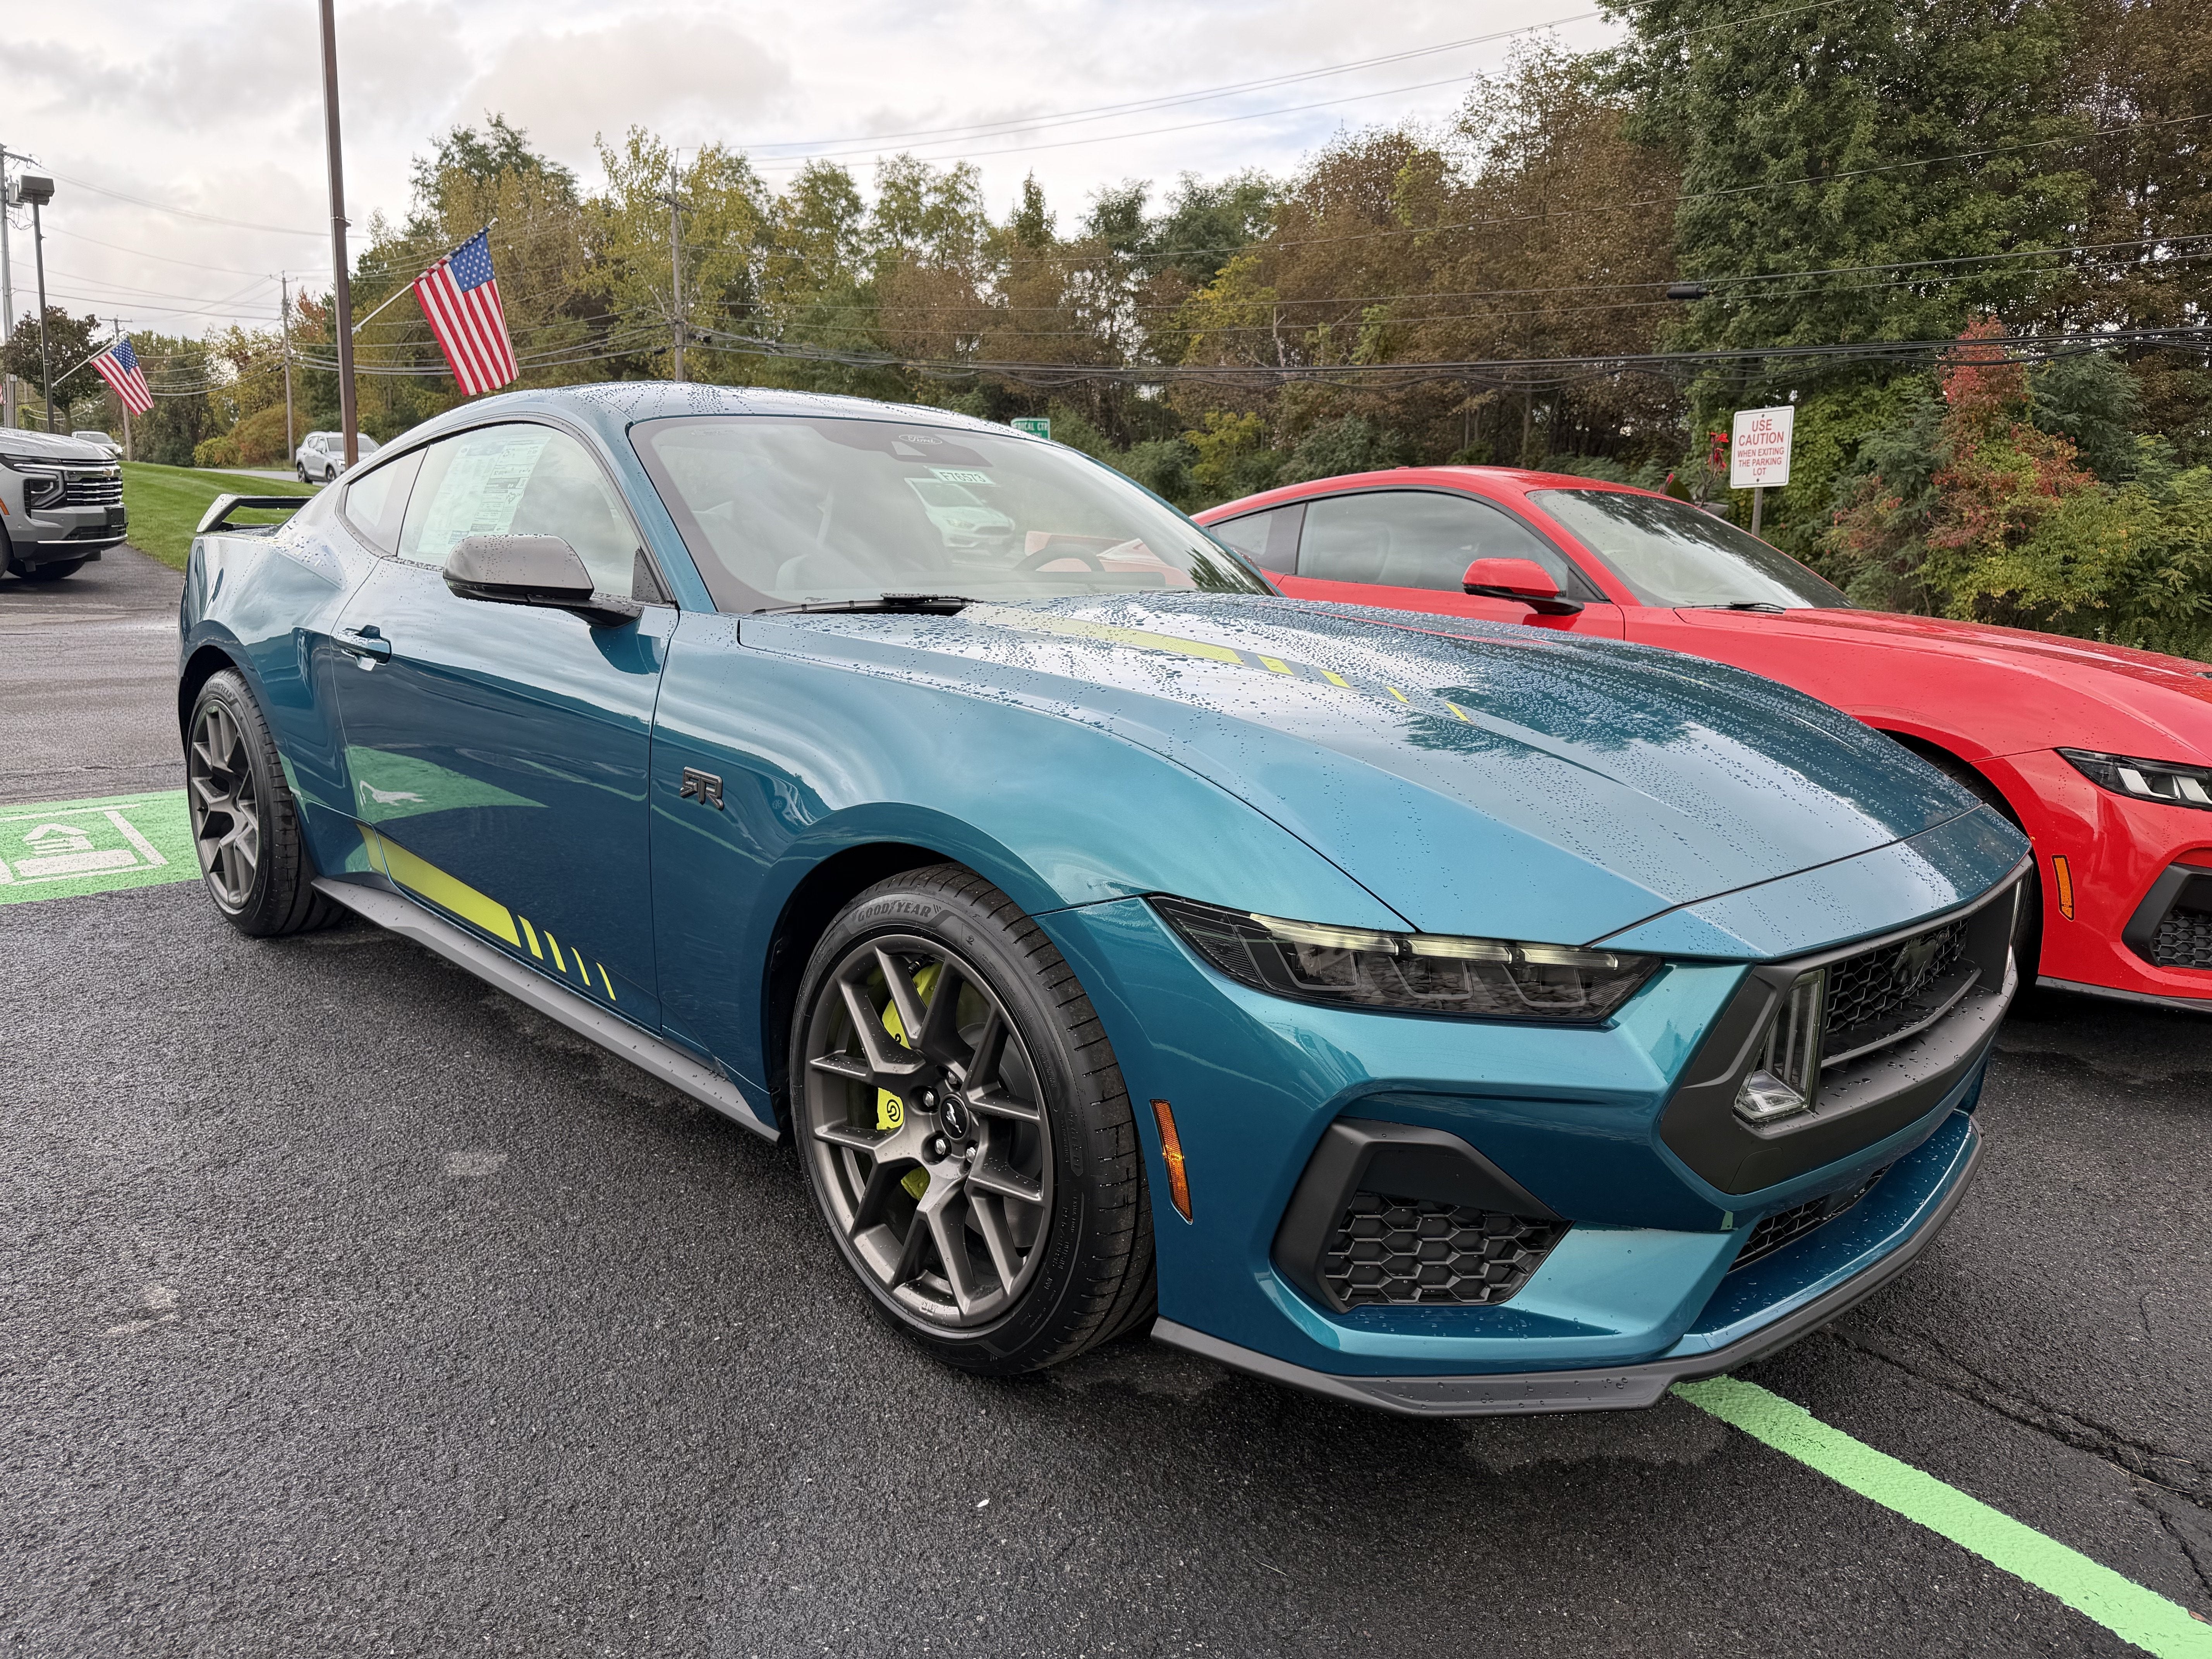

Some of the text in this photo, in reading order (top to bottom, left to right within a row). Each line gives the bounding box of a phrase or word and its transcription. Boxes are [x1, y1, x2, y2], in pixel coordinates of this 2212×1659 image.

[1752, 419, 1772, 432] USE
[907, 435, 936, 443] Ford
[1739, 431, 1784, 446] CAUTION
[1738, 447, 1784, 458] WHEN EXITING
[1739, 457, 1782, 467] THE PARKING
[1753, 467, 1766, 476] LOT
[939, 472, 986, 482] F76573
[858, 900, 931, 922] GOODYEAR
